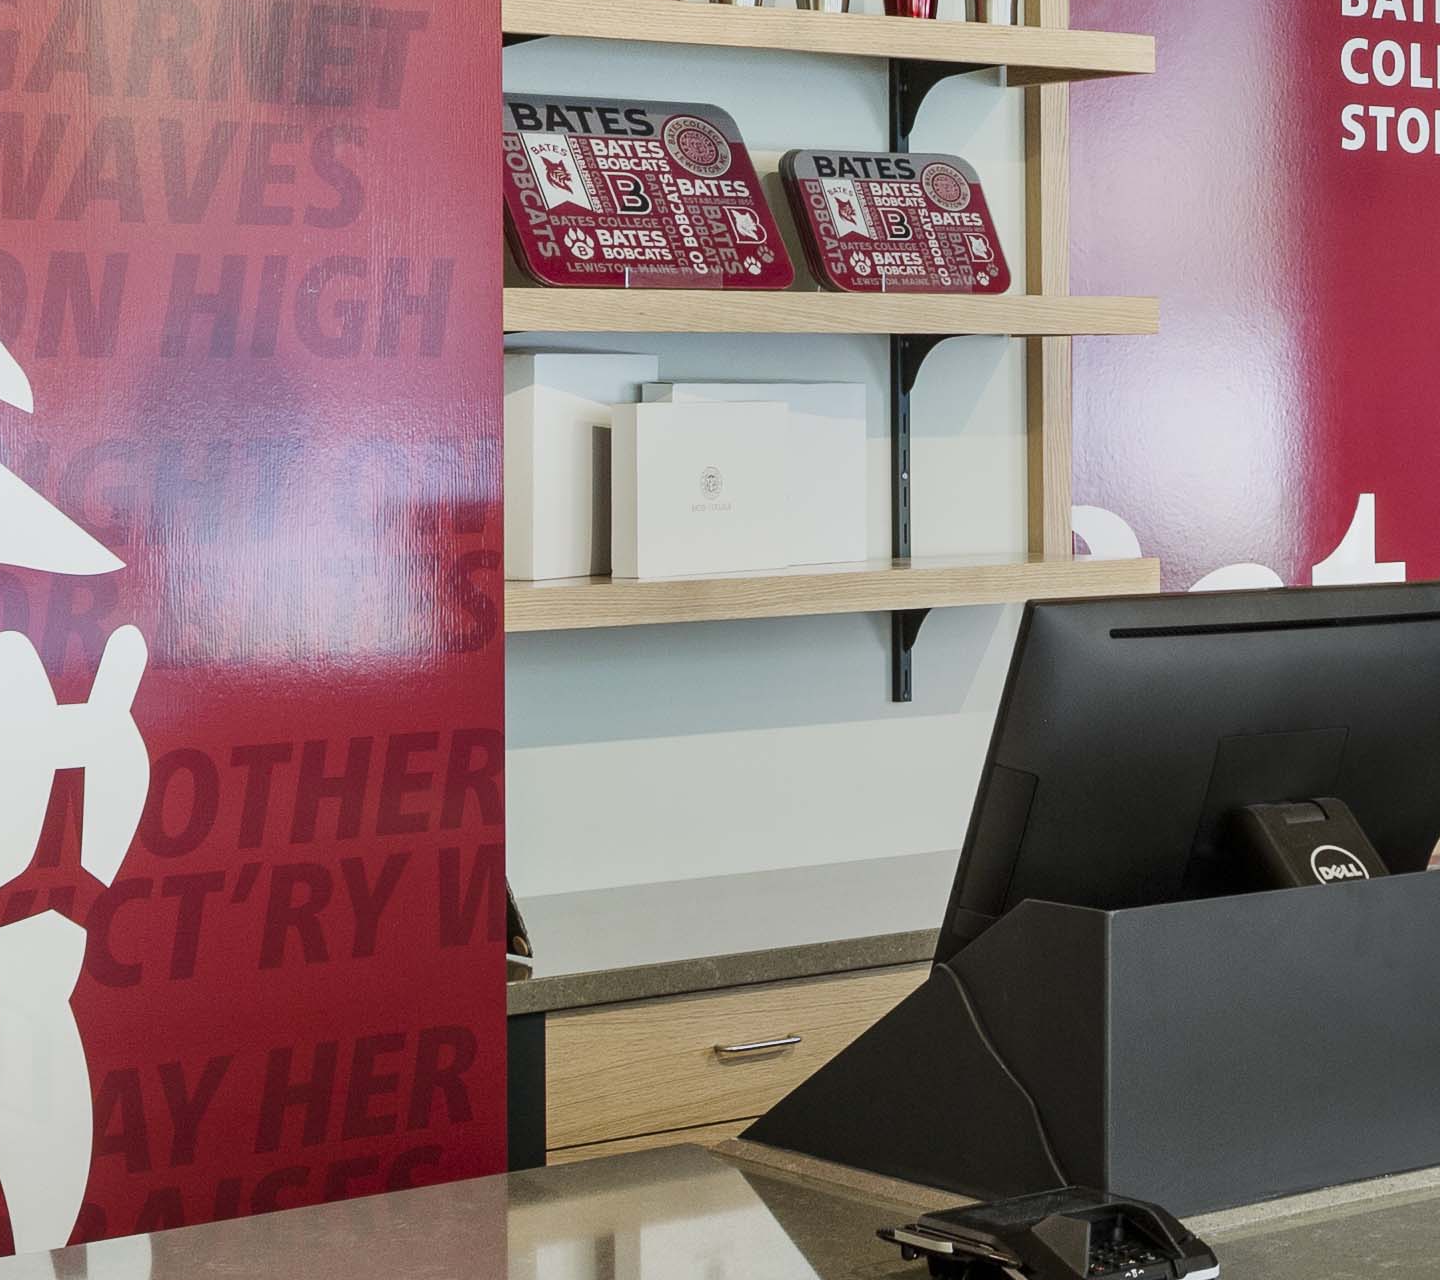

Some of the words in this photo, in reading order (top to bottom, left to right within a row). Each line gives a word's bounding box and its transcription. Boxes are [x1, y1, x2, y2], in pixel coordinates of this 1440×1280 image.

[508, 102, 656, 137] BATES
[530, 142, 569, 157] BATES
[589, 138, 666, 159] BATES
[596, 157, 670, 172] BOBCATS
[812, 155, 916, 181] BATES
[503, 136, 561, 259] BOBCATS
[676, 178, 751, 198] BATES
[869, 182, 923, 198] BATES
[659, 170, 697, 249] BOBCATS
[873, 196, 927, 208] BOBCATS
[549, 215, 596, 227] BATES
[598, 216, 662, 229] COLLEGE
[804, 180, 848, 275] BOBCATS
[931, 212, 984, 226] BATES
[595, 228, 667, 248] BATES
[703, 206, 744, 276] BATES
[918, 208, 946, 266] BOBCATS
[604, 247, 673, 261] BOBCATS
[872, 251, 923, 265] BATES
[876, 265, 926, 277] BOBCATS
[160, 255, 455, 360] HIGH
[1318, 863, 1363, 881] DELL
[93, 1055, 236, 1176] AY
[253, 1023, 479, 1155] HER
